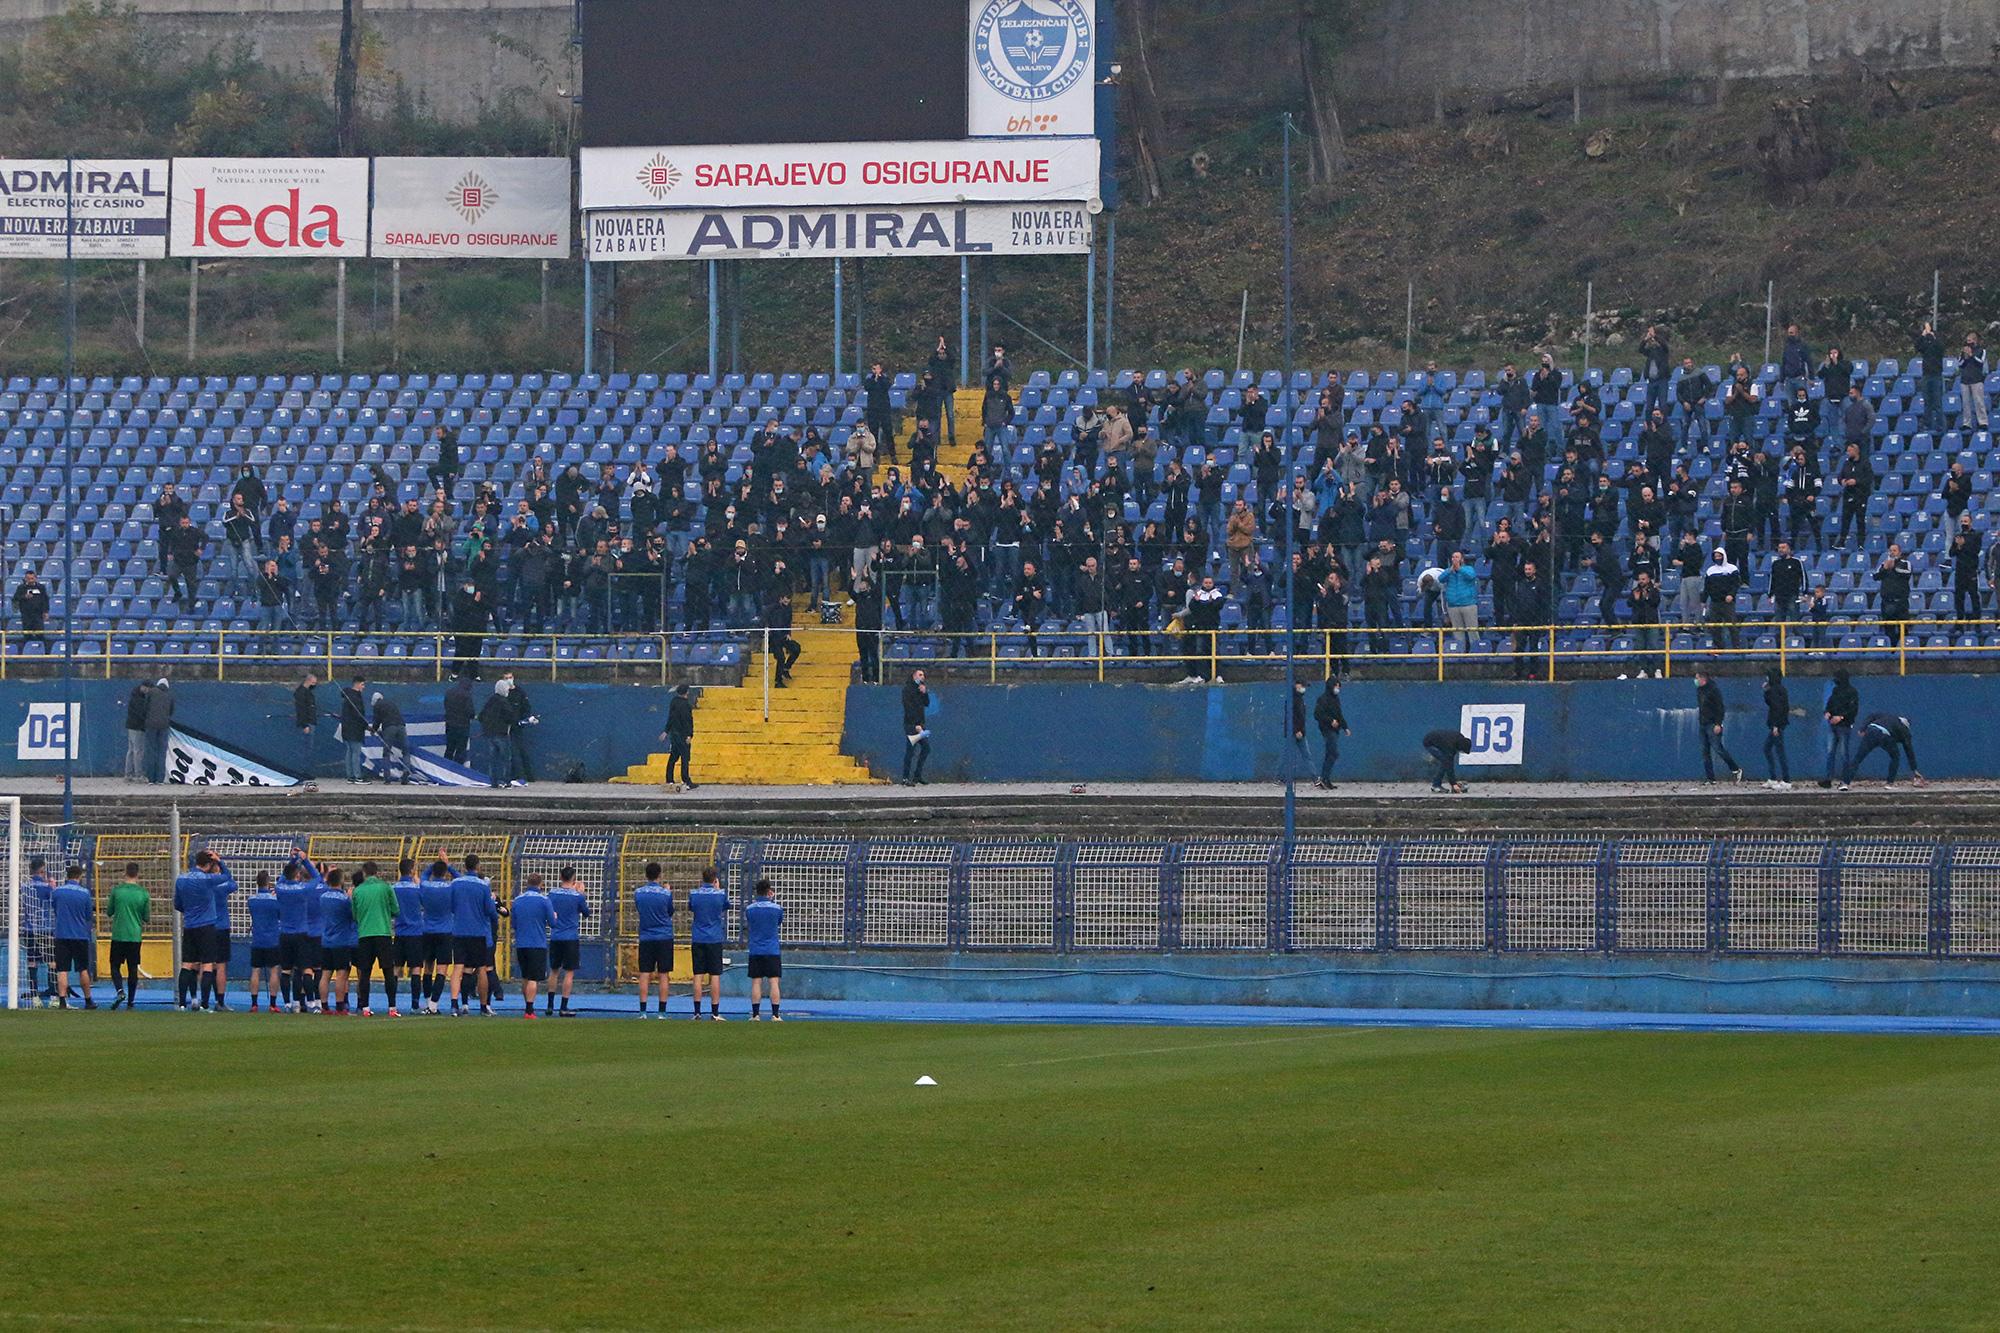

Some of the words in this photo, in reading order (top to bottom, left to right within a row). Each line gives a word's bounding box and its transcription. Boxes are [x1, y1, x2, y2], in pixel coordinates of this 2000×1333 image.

[1001, 18, 1068, 28] ŽELJEZNIČAR
[981, 60, 1051, 99] FOOTBALL
[1052, 59, 1085, 92] CLUB
[695, 162, 846, 187] SARAJEVO
[862, 160, 1049, 185] OSIGURANJE
[7, 198, 90, 208] ELECTRONIC
[93, 199, 145, 208] CASINO
[4, 218, 41, 233] NOVA
[45, 218, 69, 234] ERA
[75, 219, 136, 234] ZABAVE!
[191, 187, 345, 248] leda
[595, 218, 634, 236] NOVA
[636, 217, 665, 236] ERA
[1012, 211, 1051, 230] NOVA
[1054, 210, 1083, 229] ERA
[385, 233, 460, 245] SARAJEVO
[466, 233, 558, 246] OSIGURANJE
[686, 207, 993, 256] ADMIRAL
[1012, 231, 1085, 246] ZABAVE!
[595, 237, 666, 253] ZABAVE!
[28, 714, 68, 748] D2
[1471, 716, 1513, 753] D3
